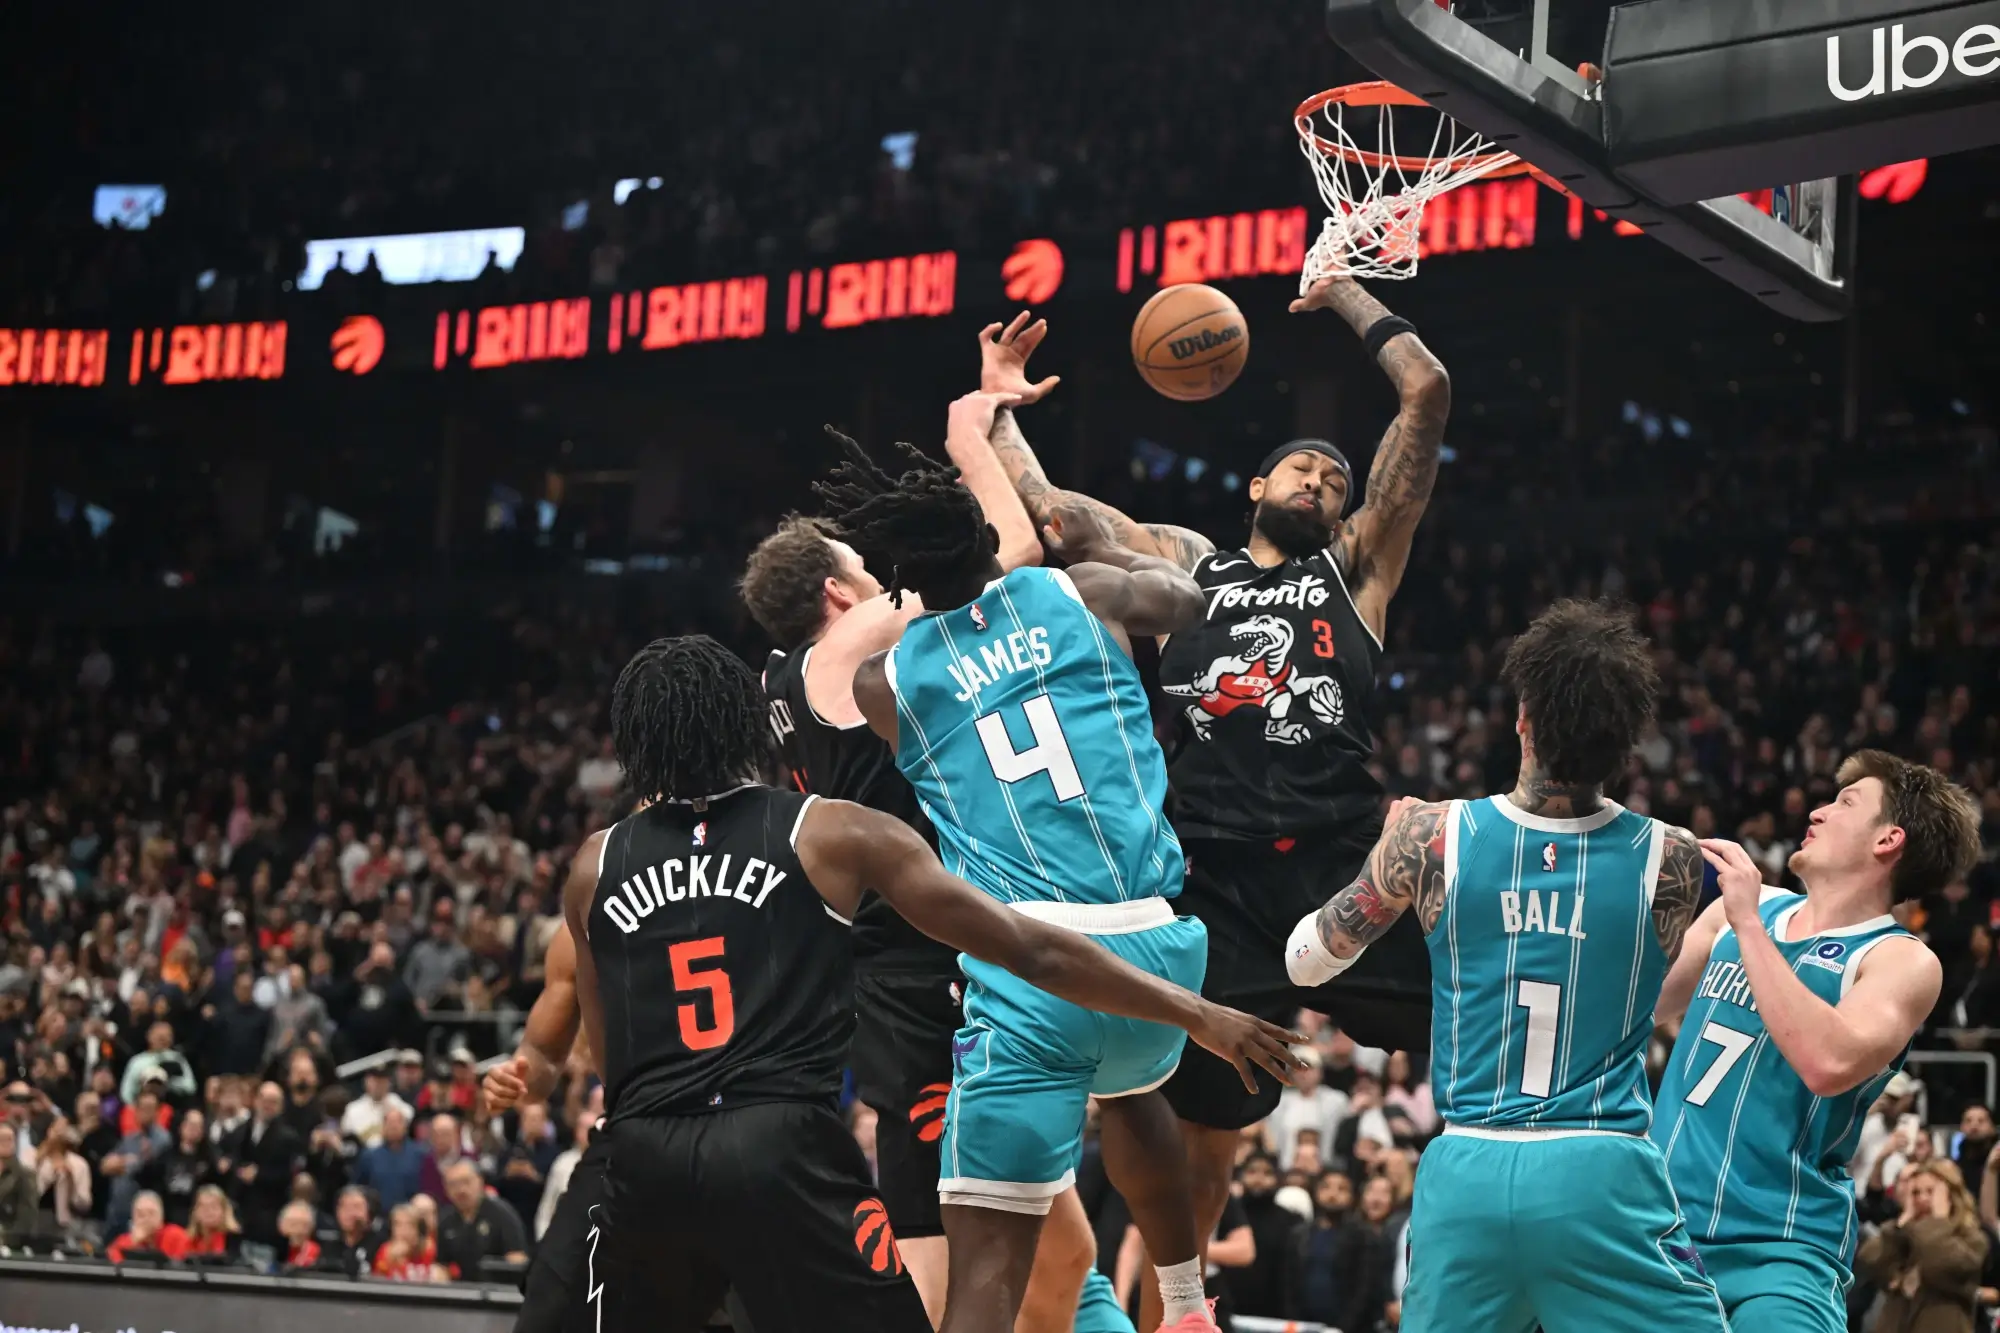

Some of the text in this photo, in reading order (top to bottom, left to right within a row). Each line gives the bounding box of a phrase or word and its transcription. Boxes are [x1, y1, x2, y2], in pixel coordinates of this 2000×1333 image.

[1827, 24, 2000, 101] Ube
[1168, 326, 1241, 361] Wilson
[1203, 575, 1330, 620] Toronto
[946, 626, 1052, 702] JAMES
[1312, 617, 1335, 659] 3
[974, 693, 1087, 804] 4
[603, 854, 788, 934] QUICKLEY
[1500, 889, 1587, 940] BALL
[668, 936, 735, 1050] 5
[1516, 978, 1562, 1099] 1
[1683, 1020, 1756, 1108] 7
